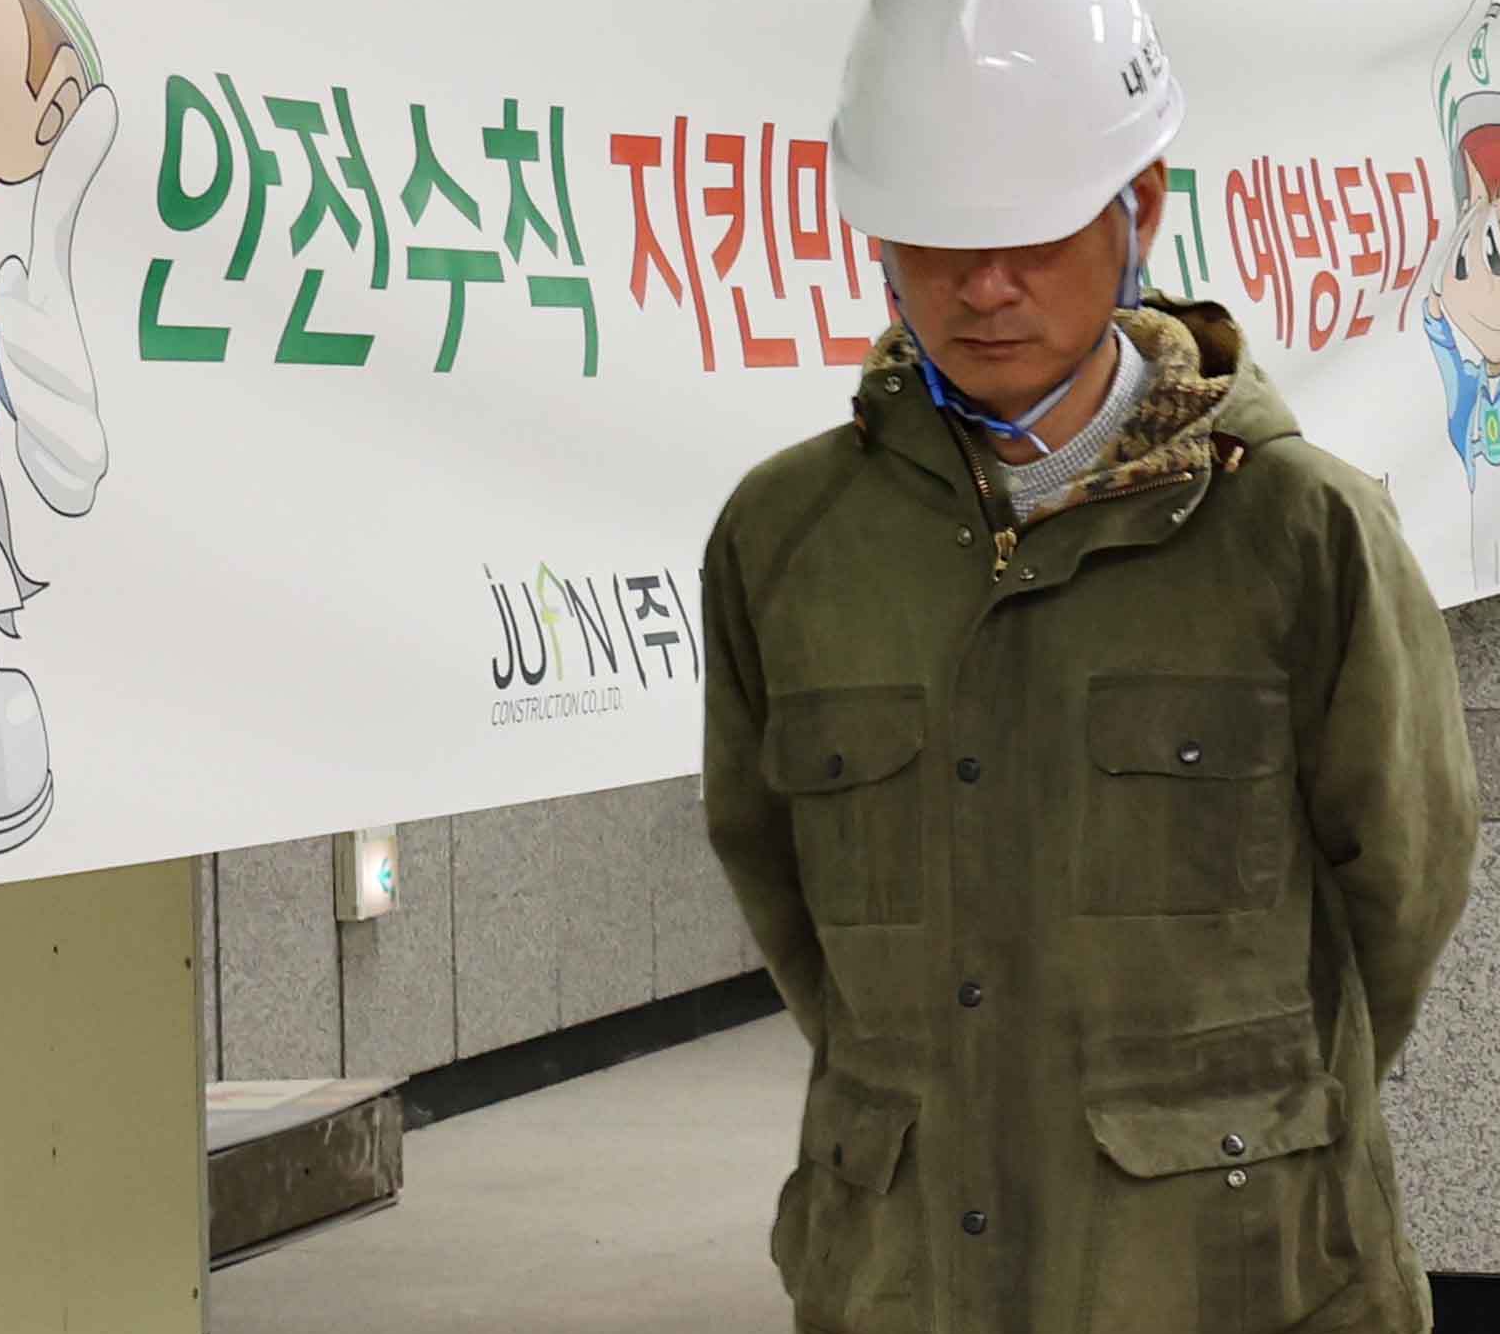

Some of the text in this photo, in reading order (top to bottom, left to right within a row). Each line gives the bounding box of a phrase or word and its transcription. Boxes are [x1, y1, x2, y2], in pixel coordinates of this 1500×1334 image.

[137, 70, 600, 378] 안전수칙
[609, 113, 897, 373] 지킨만
[1224, 154, 1440, 353] 예방된다
[490, 694, 581, 727] CONSTRUCTION
